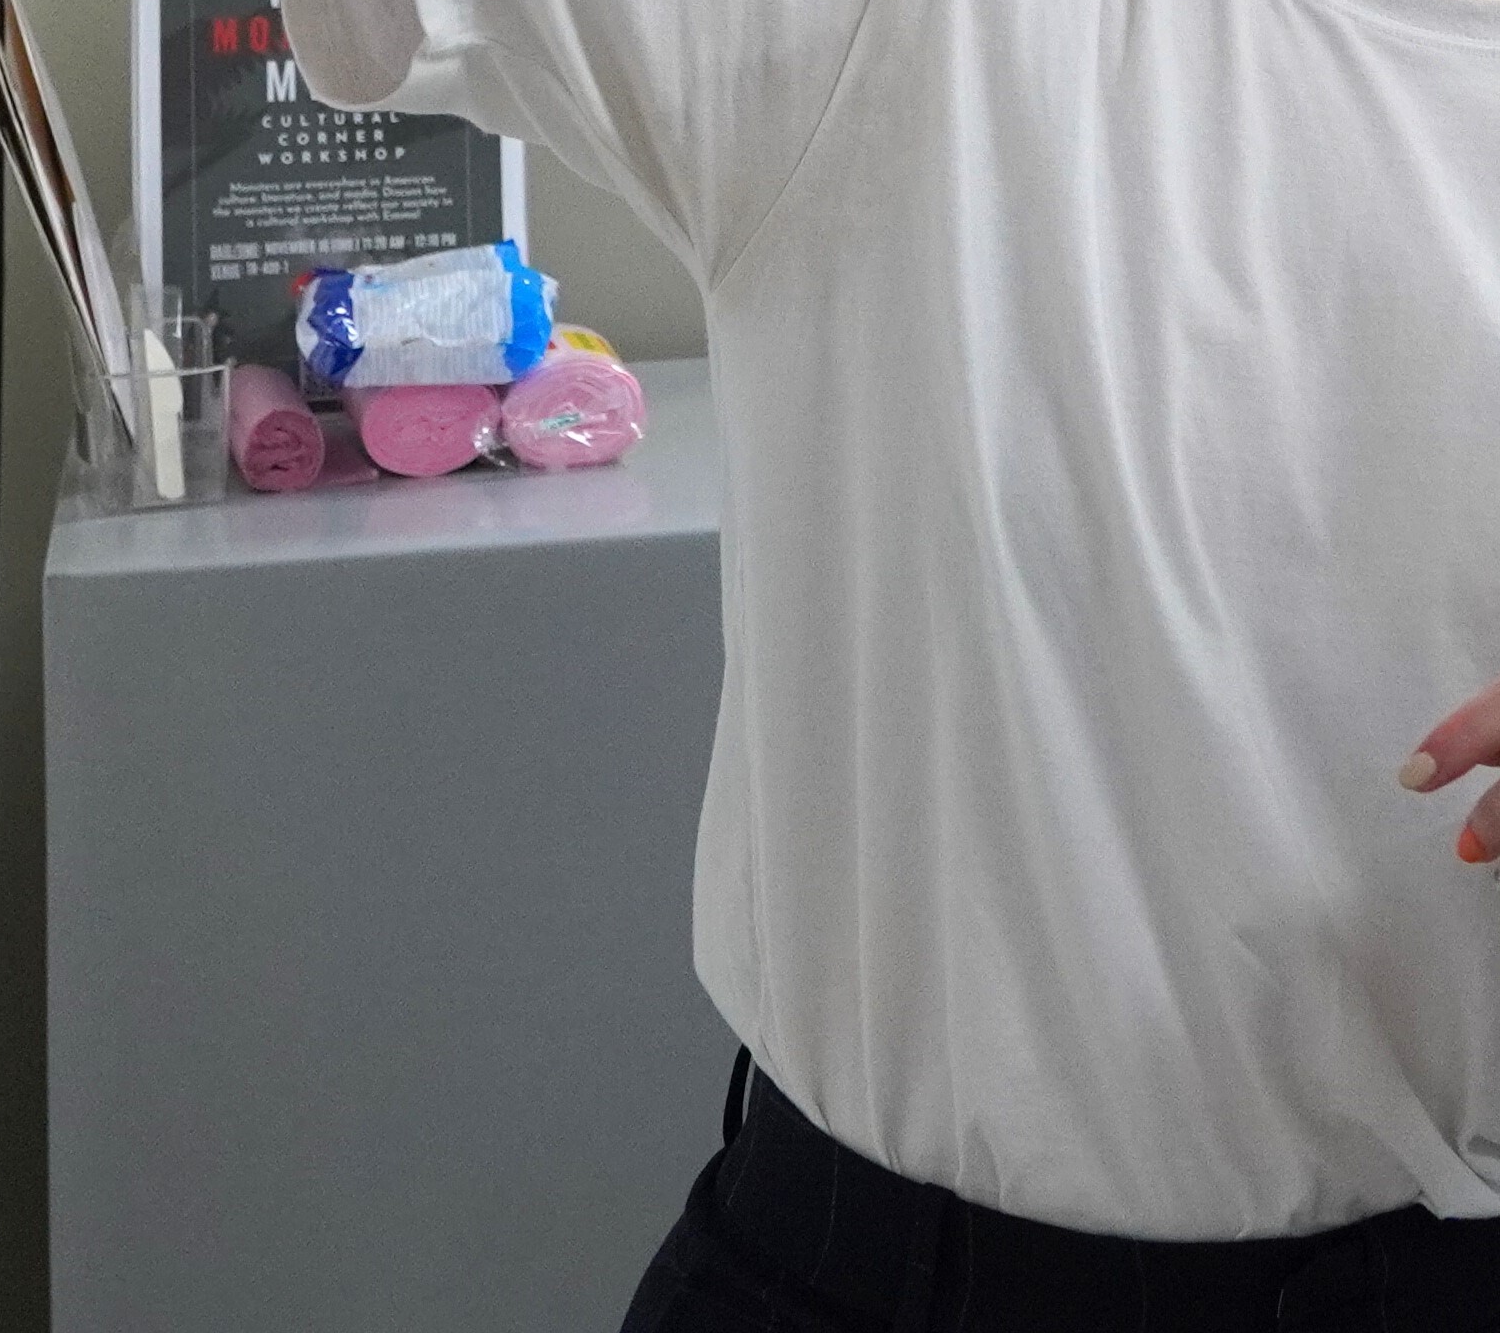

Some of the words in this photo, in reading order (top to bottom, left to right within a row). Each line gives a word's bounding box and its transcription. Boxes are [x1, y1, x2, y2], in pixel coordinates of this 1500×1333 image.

[261, 110, 401, 129] CULTURAL
[277, 129, 384, 147] CORNER
[257, 145, 406, 165] WORKSHOP
[229, 181, 280, 194] Monsters
[283, 182, 302, 191] are
[383, 175, 436, 185] American
[317, 190, 341, 202] and
